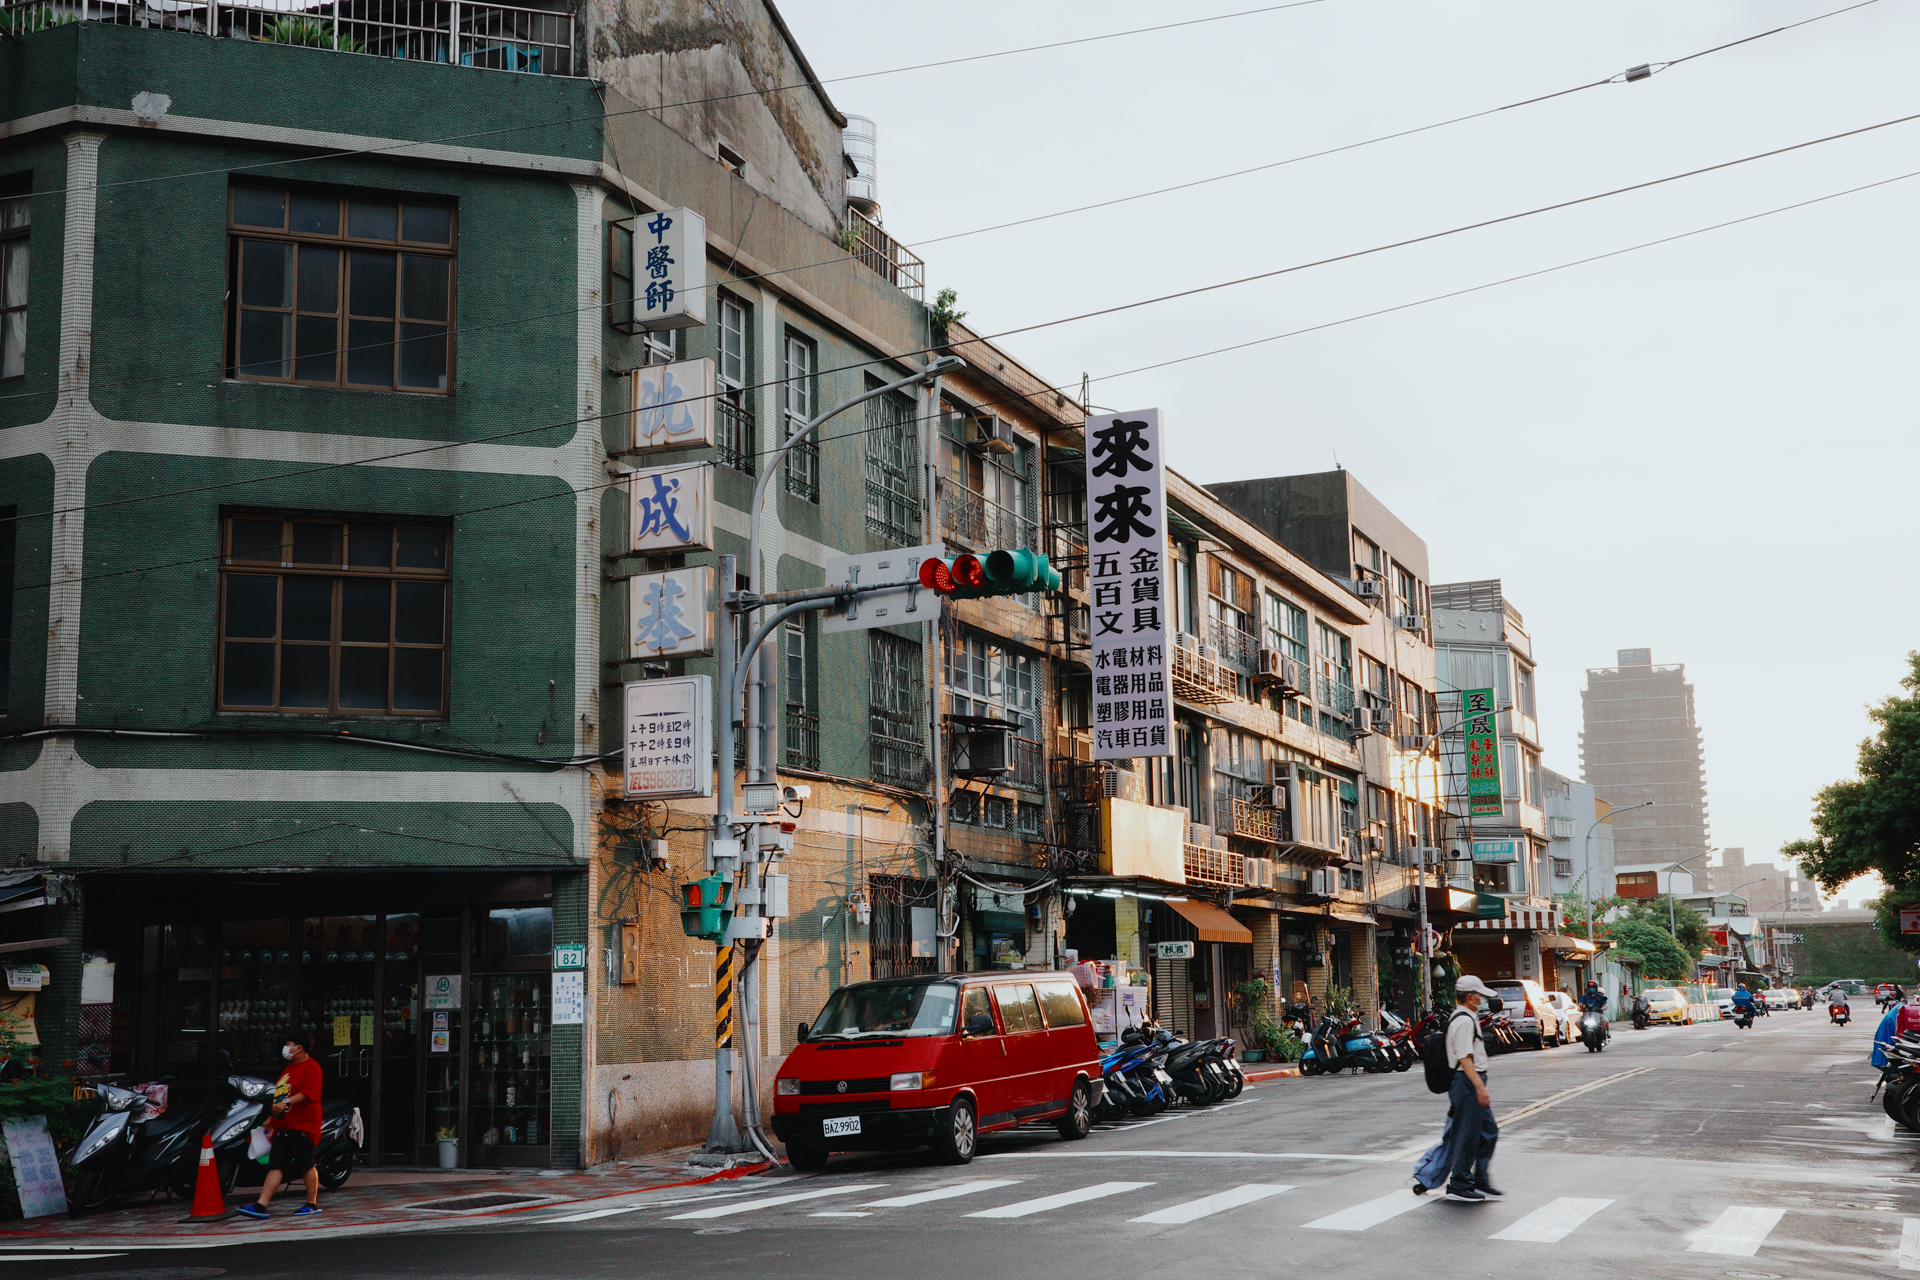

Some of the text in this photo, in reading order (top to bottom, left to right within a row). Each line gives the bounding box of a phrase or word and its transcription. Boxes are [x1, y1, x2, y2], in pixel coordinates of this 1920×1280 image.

[645, 212, 675, 313] 中醫師
[640, 371, 695, 437] 沈
[1092, 418, 1156, 545] 來來
[638, 474, 691, 543] 成
[635, 582, 696, 651] 基
[1095, 645, 1163, 670] 水電材料
[1096, 671, 1164, 696] 電器用品
[1096, 698, 1165, 723] 塑膠用品
[1097, 725, 1166, 749] 汽車百貨
[629, 754, 692, 768] 星期日下午休診
[563, 953, 577, 965] 82
